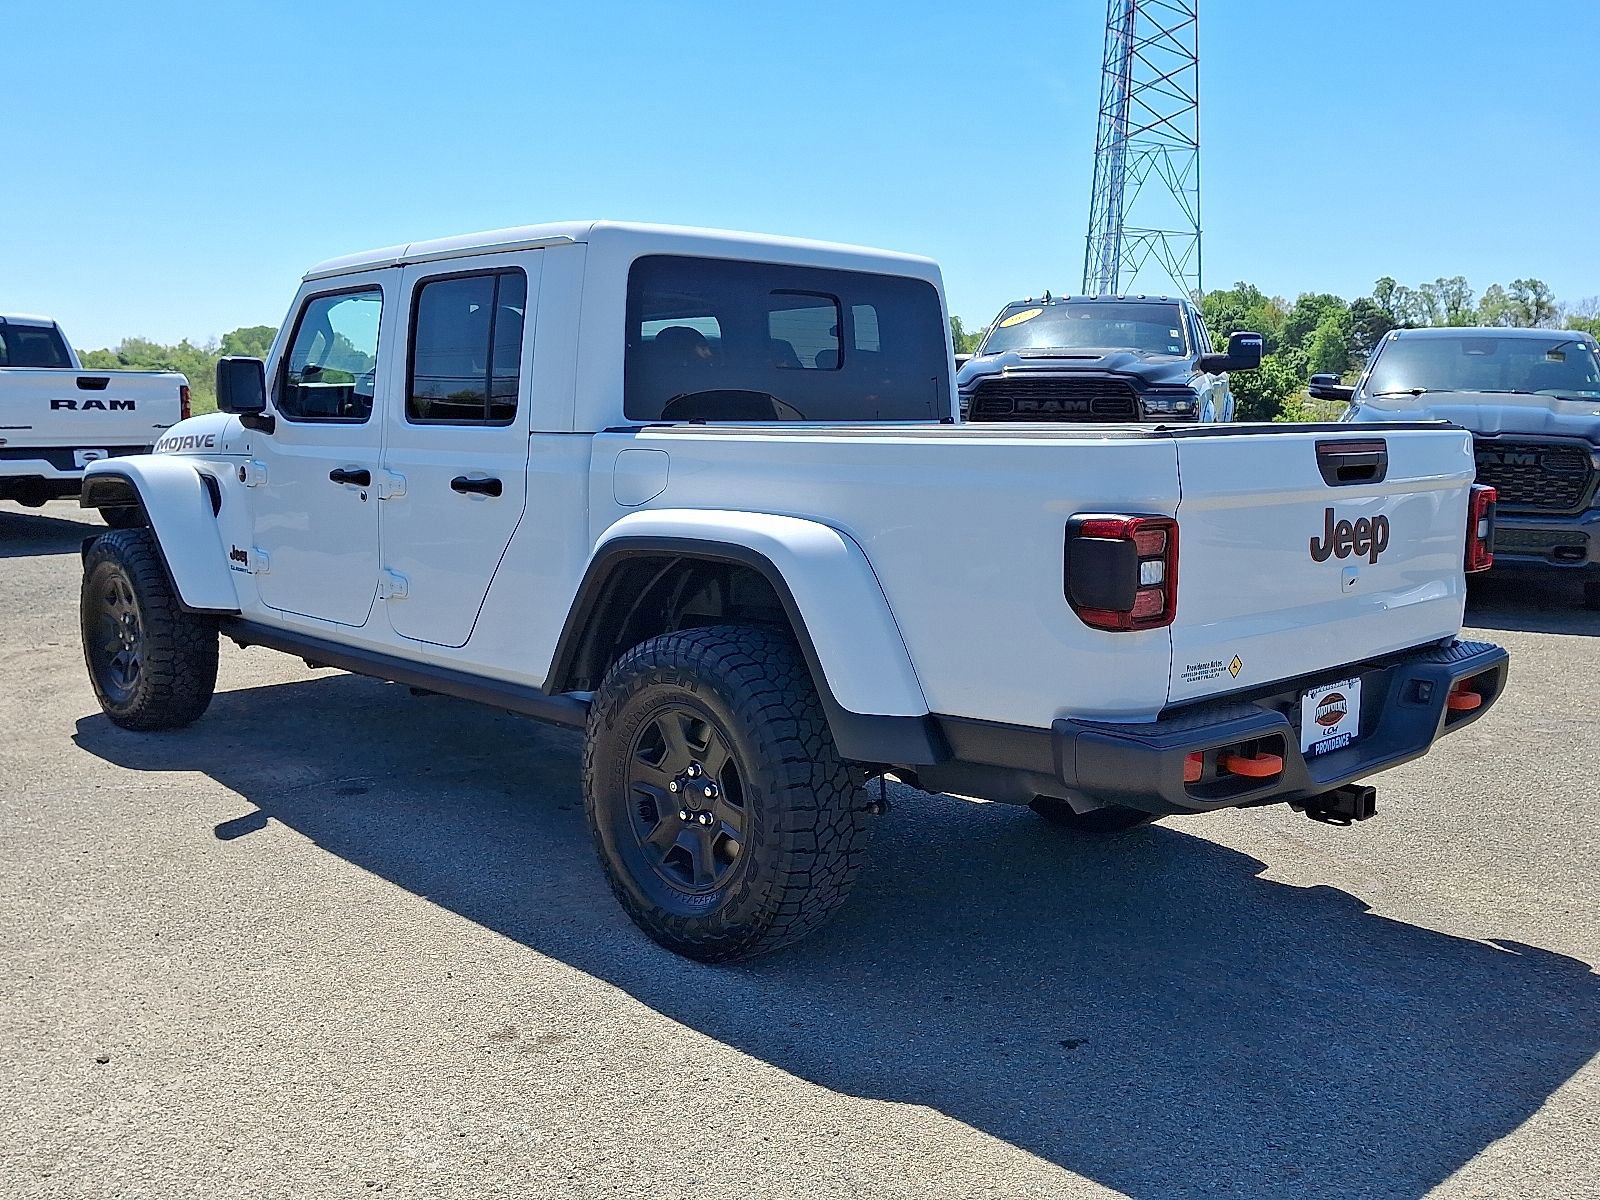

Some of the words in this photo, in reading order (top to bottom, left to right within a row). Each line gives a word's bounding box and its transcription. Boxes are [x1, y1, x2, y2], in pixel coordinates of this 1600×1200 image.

[50, 400, 136, 411] RAM
[1017, 400, 1088, 411] RAM
[156, 434, 216, 452] MOJAVE
[1476, 452, 1537, 466] AM
[1309, 507, 1390, 565] Jeep
[229, 544, 248, 567] Jeep
[1316, 734, 1350, 755] PROVIDENCE
